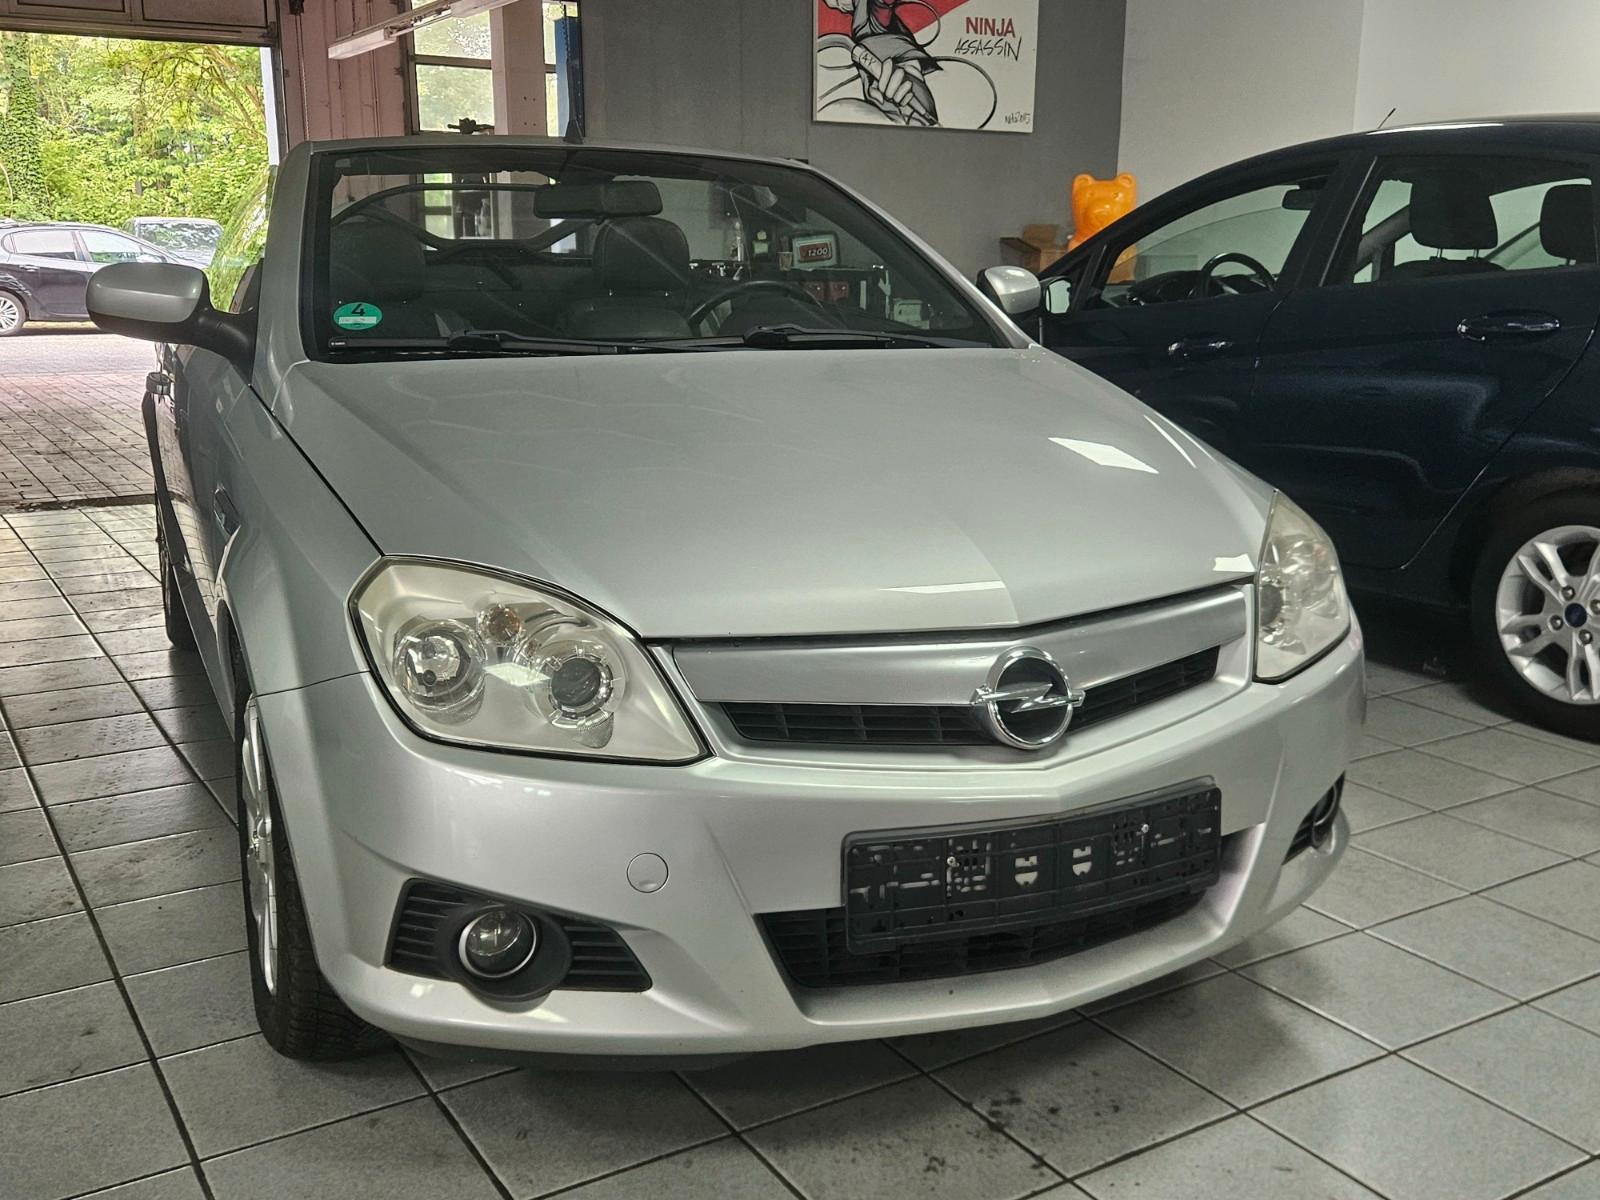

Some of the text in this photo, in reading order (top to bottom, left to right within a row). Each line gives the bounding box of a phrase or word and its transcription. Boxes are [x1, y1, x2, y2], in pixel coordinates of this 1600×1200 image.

[966, 16, 1016, 38] NINJA
[954, 36, 1022, 61] ASSASSIN
[351, 303, 366, 316] 4
